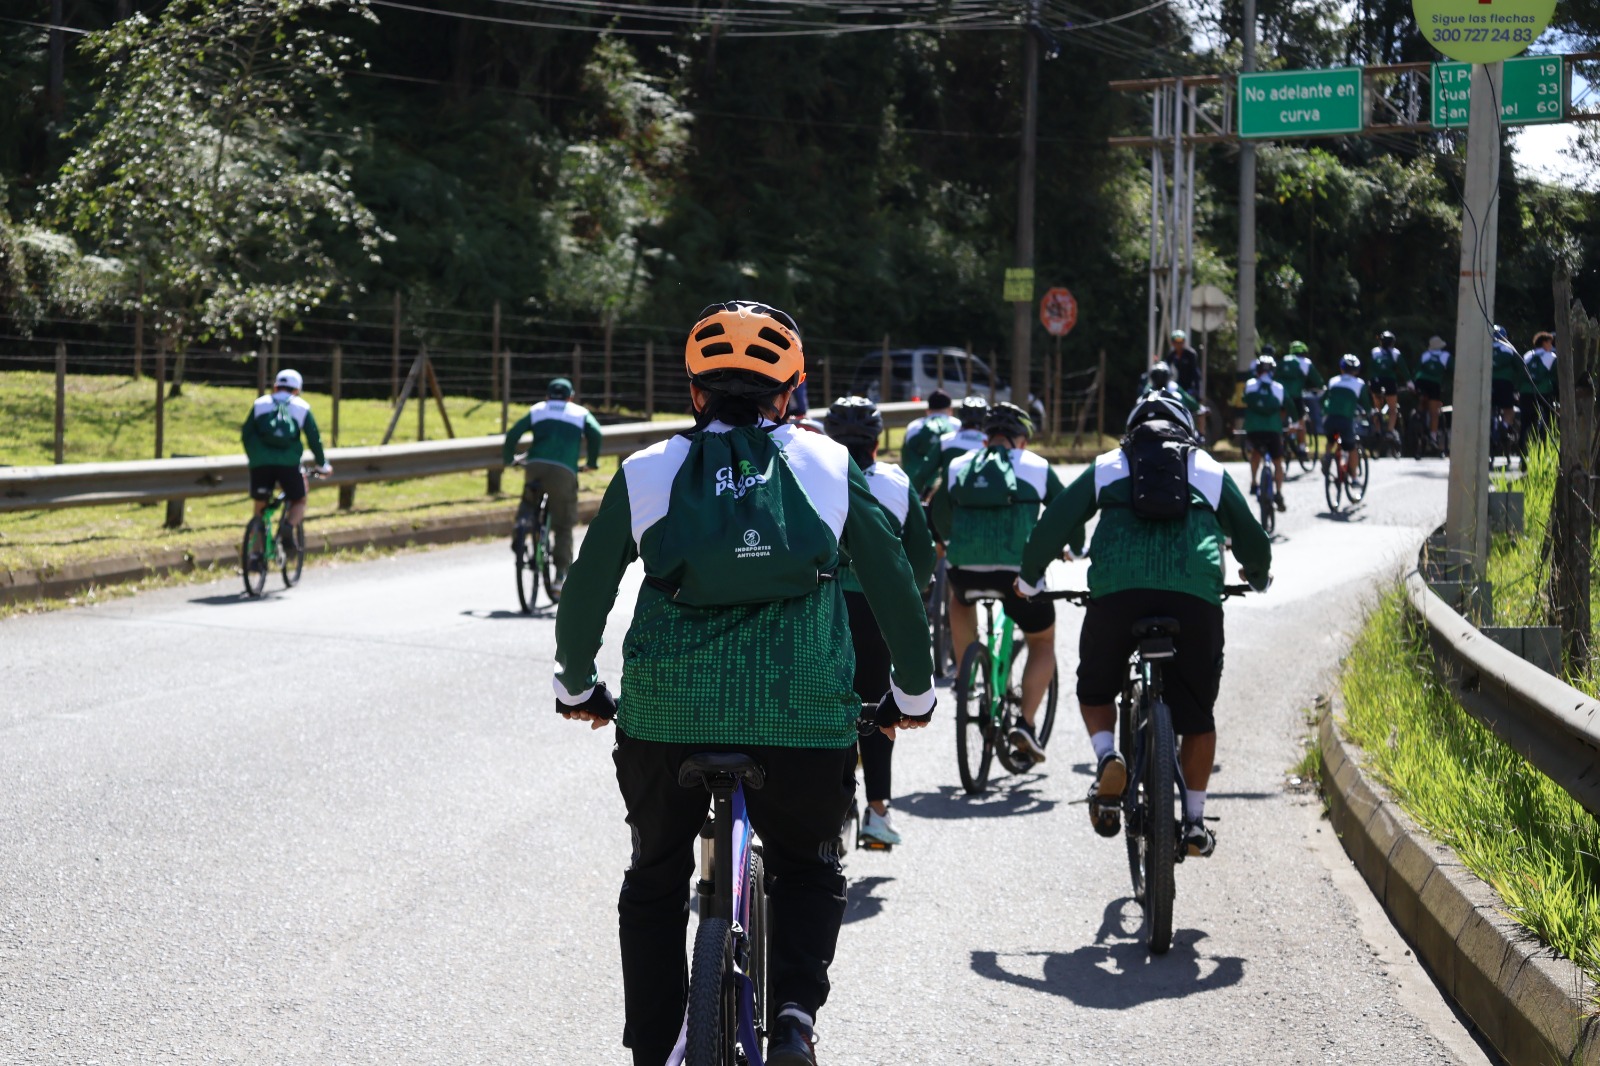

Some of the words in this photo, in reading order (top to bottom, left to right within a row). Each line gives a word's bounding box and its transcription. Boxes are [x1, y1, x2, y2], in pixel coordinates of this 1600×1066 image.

[1432, 13, 1465, 26] Sigue
[1469, 14, 1487, 23] las
[1490, 14, 1535, 23] flechas
[1433, 28, 1461, 41] 300
[1464, 28, 1489, 41] 727
[1491, 28, 1511, 42] 24
[1513, 28, 1532, 42] 83
[1440, 70, 1453, 83] El
[1540, 64, 1556, 76] 19
[1246, 87, 1265, 101] No
[1270, 83, 1332, 100] adelante
[1337, 84, 1354, 96] en
[1537, 82, 1559, 95] 33
[1439, 105, 1467, 119] San
[1536, 100, 1559, 113] 60
[1280, 109, 1320, 122] curva
